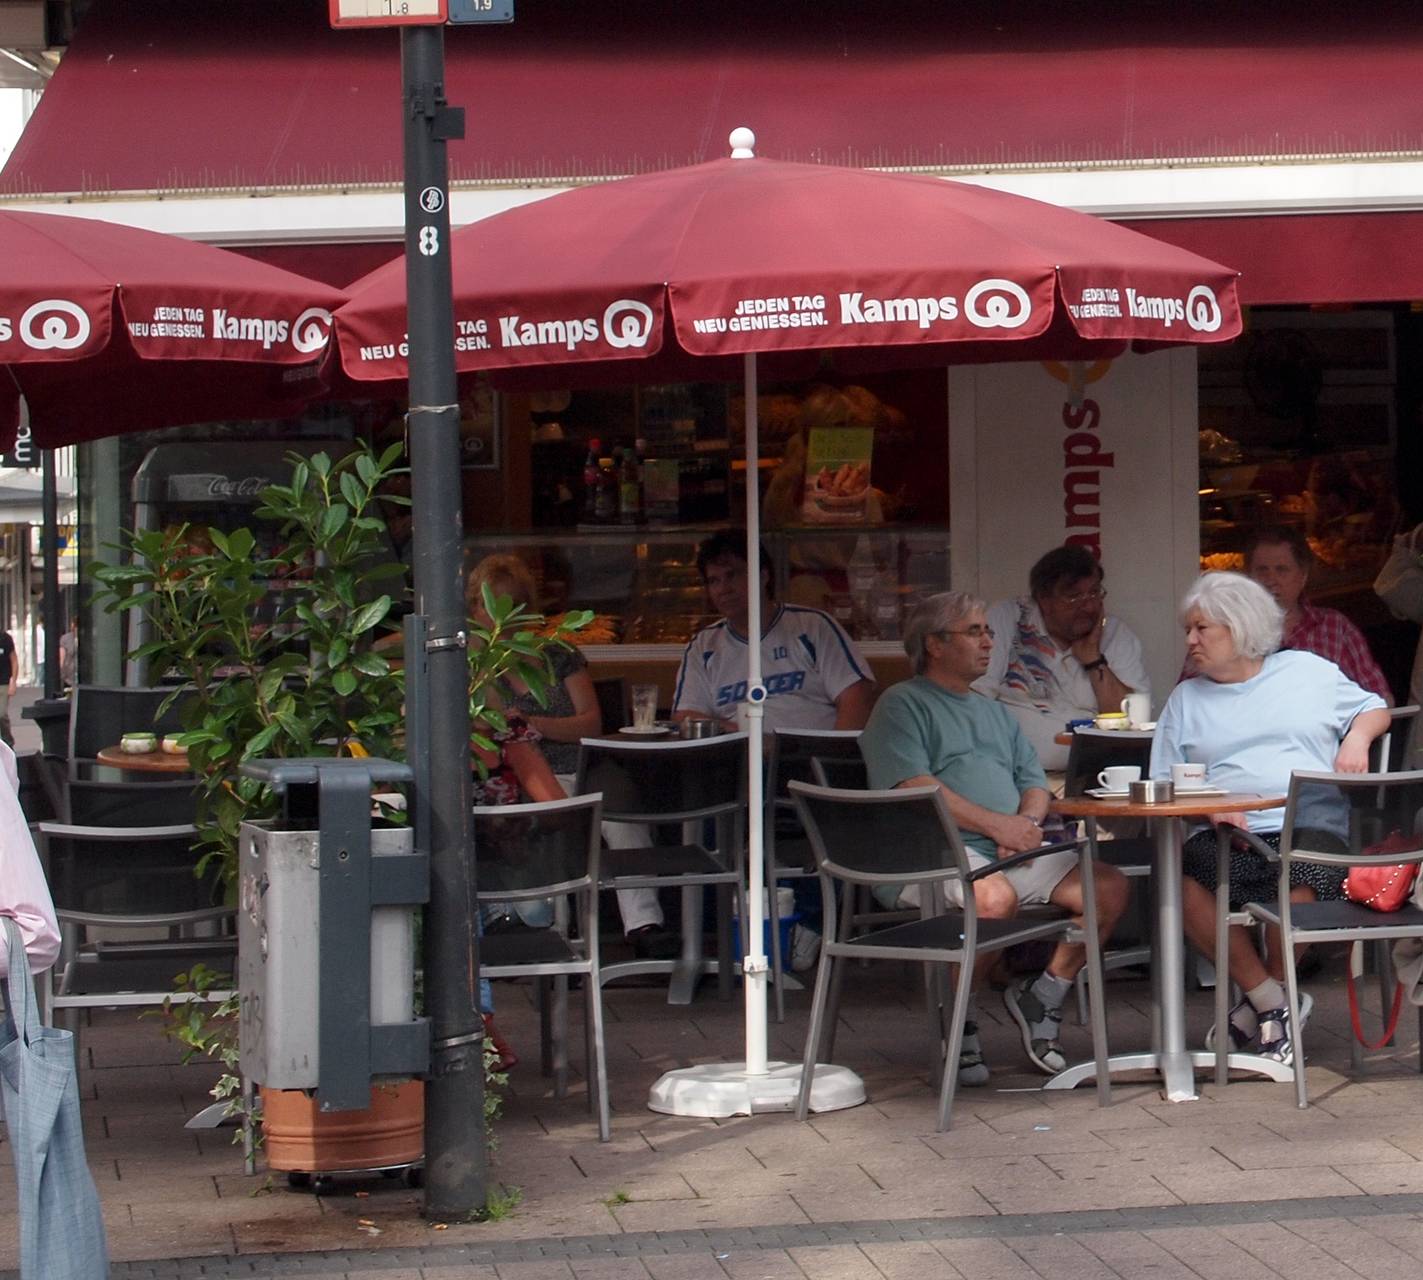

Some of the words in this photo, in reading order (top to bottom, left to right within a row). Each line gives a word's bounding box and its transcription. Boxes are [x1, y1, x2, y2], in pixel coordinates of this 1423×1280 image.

[419, 225, 439, 256] 8
[153, 306, 183, 321] JEDEN
[183, 308, 204, 321] TAG
[735, 296, 790, 315] JEDEN
[792, 295, 825, 311] TAG
[839, 292, 959, 328] Kamps
[1125, 288, 1185, 327] Kamps
[212, 309, 289, 349] Kamps
[457, 320, 488, 335] TAG
[499, 316, 599, 350] Kamps
[694, 317, 727, 334] NEU
[729, 312, 829, 333] GENIESSEN.
[360, 344, 395, 360] NEU
[1062, 399, 1115, 563] amps
[717, 671, 805, 706] SOCER
